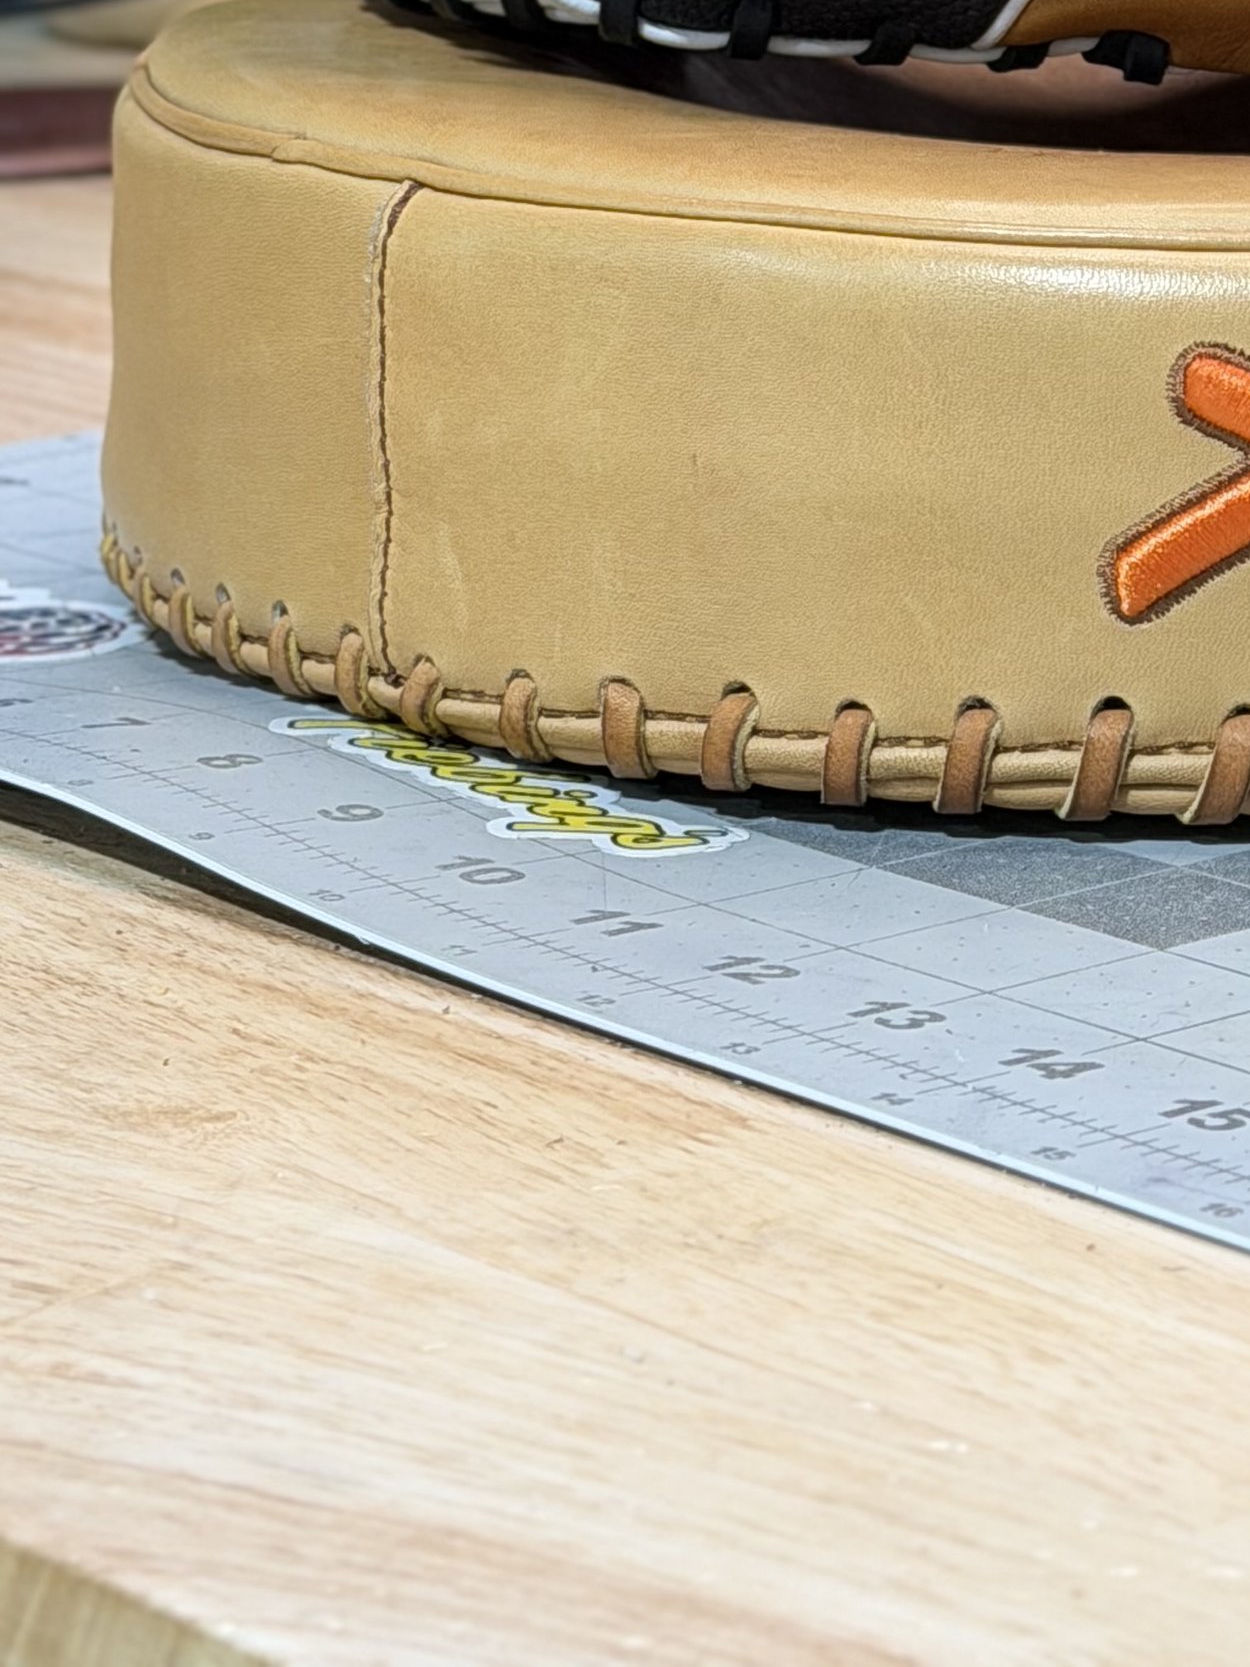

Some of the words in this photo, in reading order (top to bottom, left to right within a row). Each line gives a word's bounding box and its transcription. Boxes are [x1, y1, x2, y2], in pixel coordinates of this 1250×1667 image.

[80, 716, 152, 729] 7
[196, 753, 264, 770] 8
[316, 803, 385, 823] 9
[434, 855, 527, 886] 10
[569, 909, 665, 938] 11
[701, 955, 801, 986] 12
[846, 1001, 947, 1030] 13
[997, 1047, 1106, 1080] 14
[719, 1042, 762, 1056] 13
[1029, 1146, 1077, 1161] 15
[1199, 1202, 1245, 1218] 16
